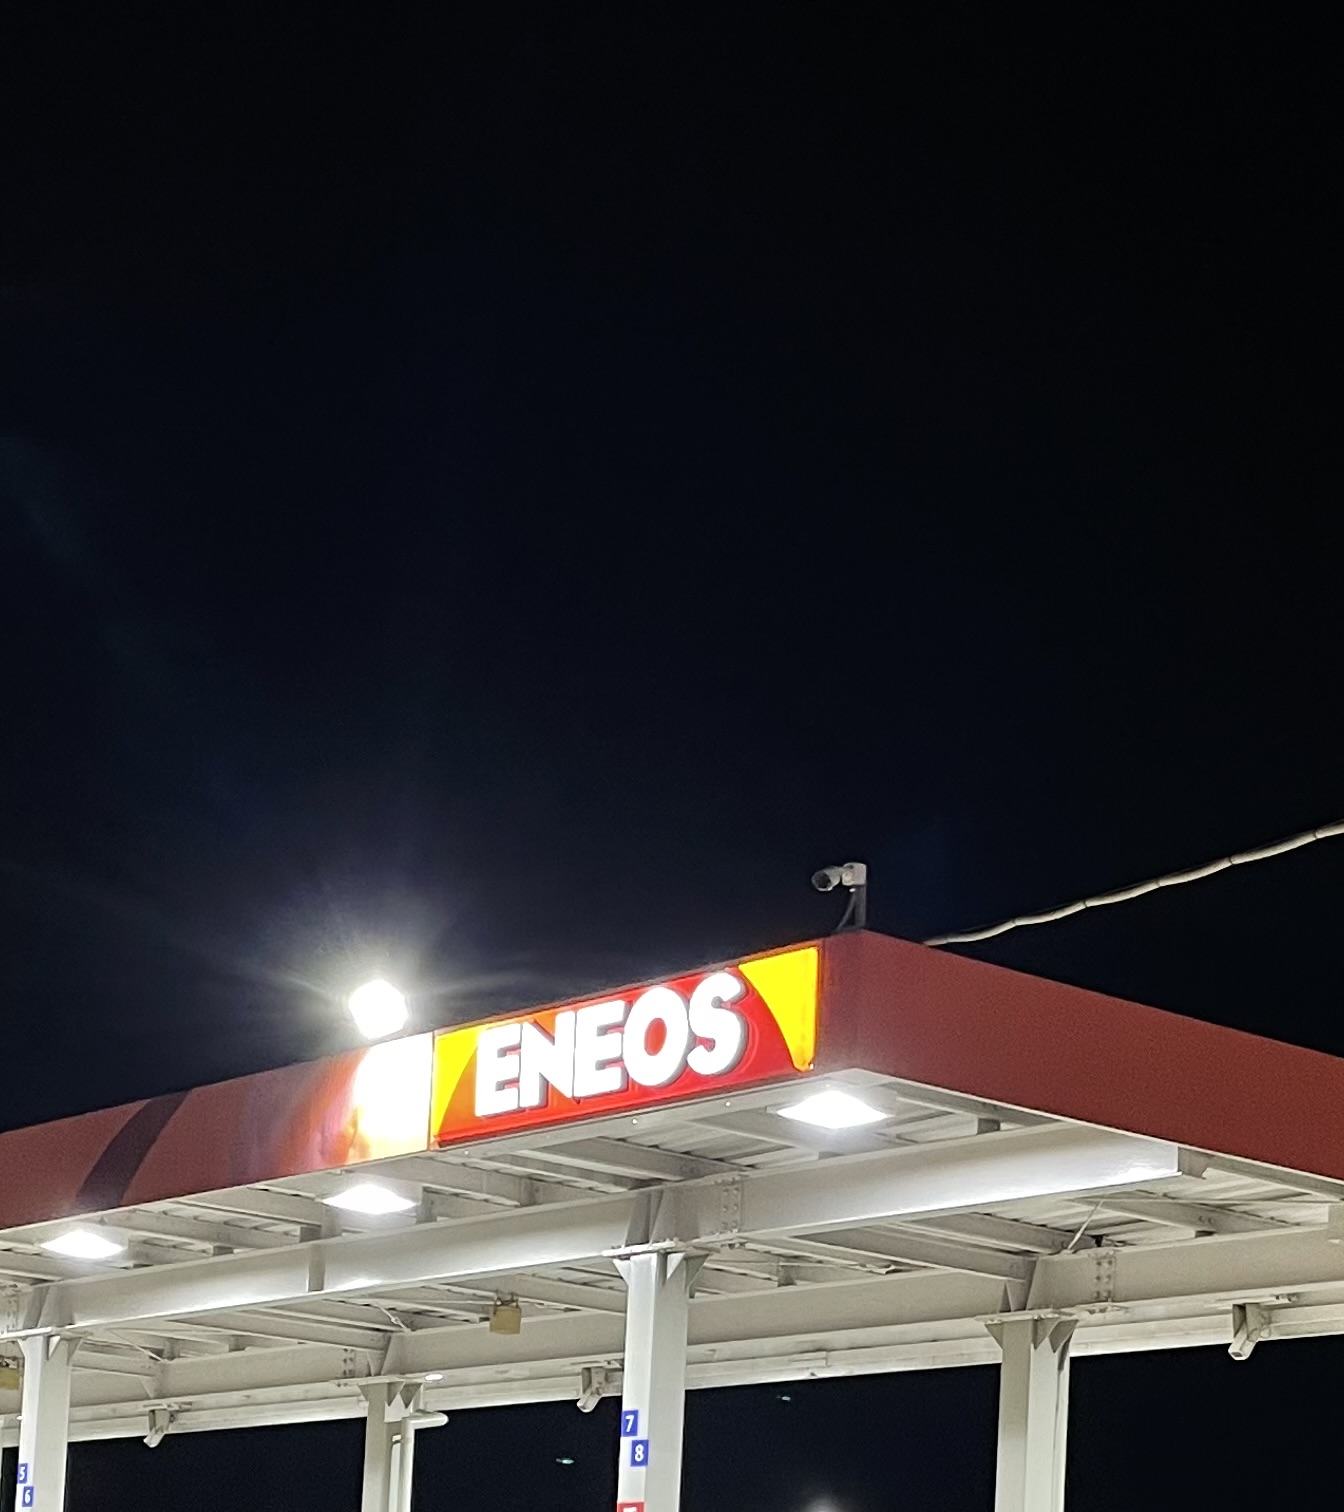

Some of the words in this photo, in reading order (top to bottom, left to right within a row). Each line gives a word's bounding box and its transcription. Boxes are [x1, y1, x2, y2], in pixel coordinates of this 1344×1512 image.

[474, 971, 749, 1117] ENEOS
[625, 1414, 635, 1433] 7
[634, 1443, 644, 1462] 8
